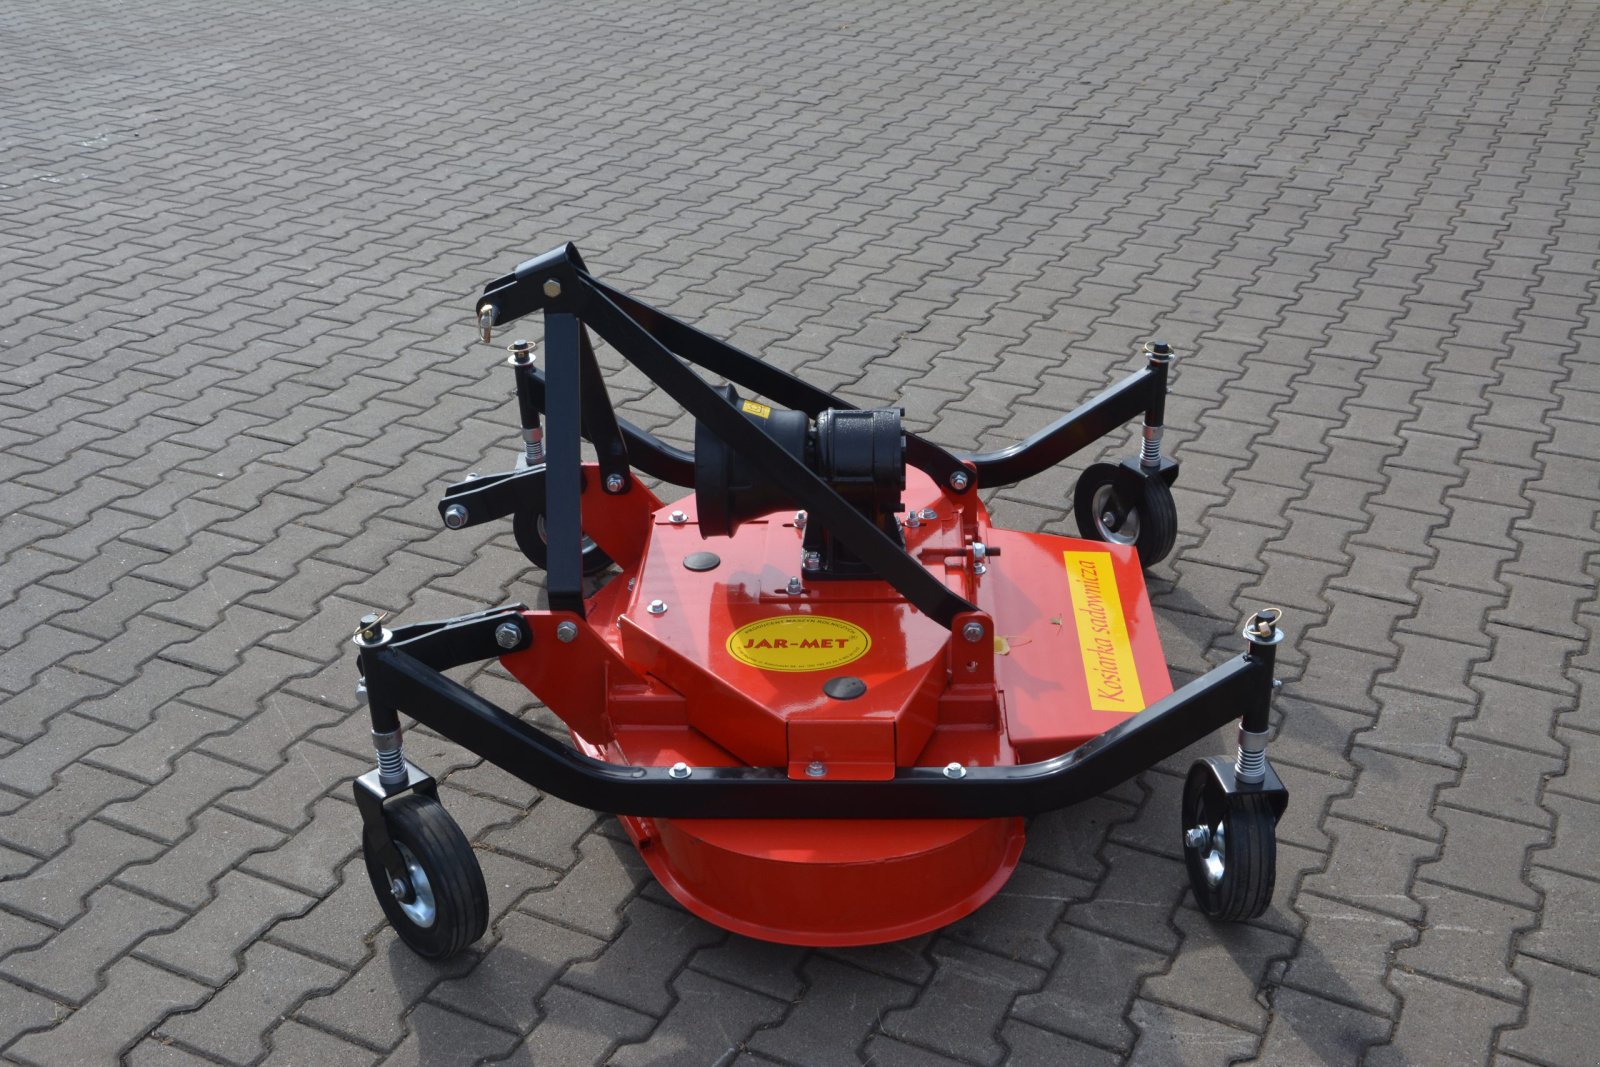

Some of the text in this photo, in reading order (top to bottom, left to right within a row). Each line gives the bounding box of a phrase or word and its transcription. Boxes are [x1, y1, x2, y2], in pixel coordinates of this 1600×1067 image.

[743, 638, 849, 649] JAR-MET
[1076, 560, 1125, 702] Kosiarka sadownicza
